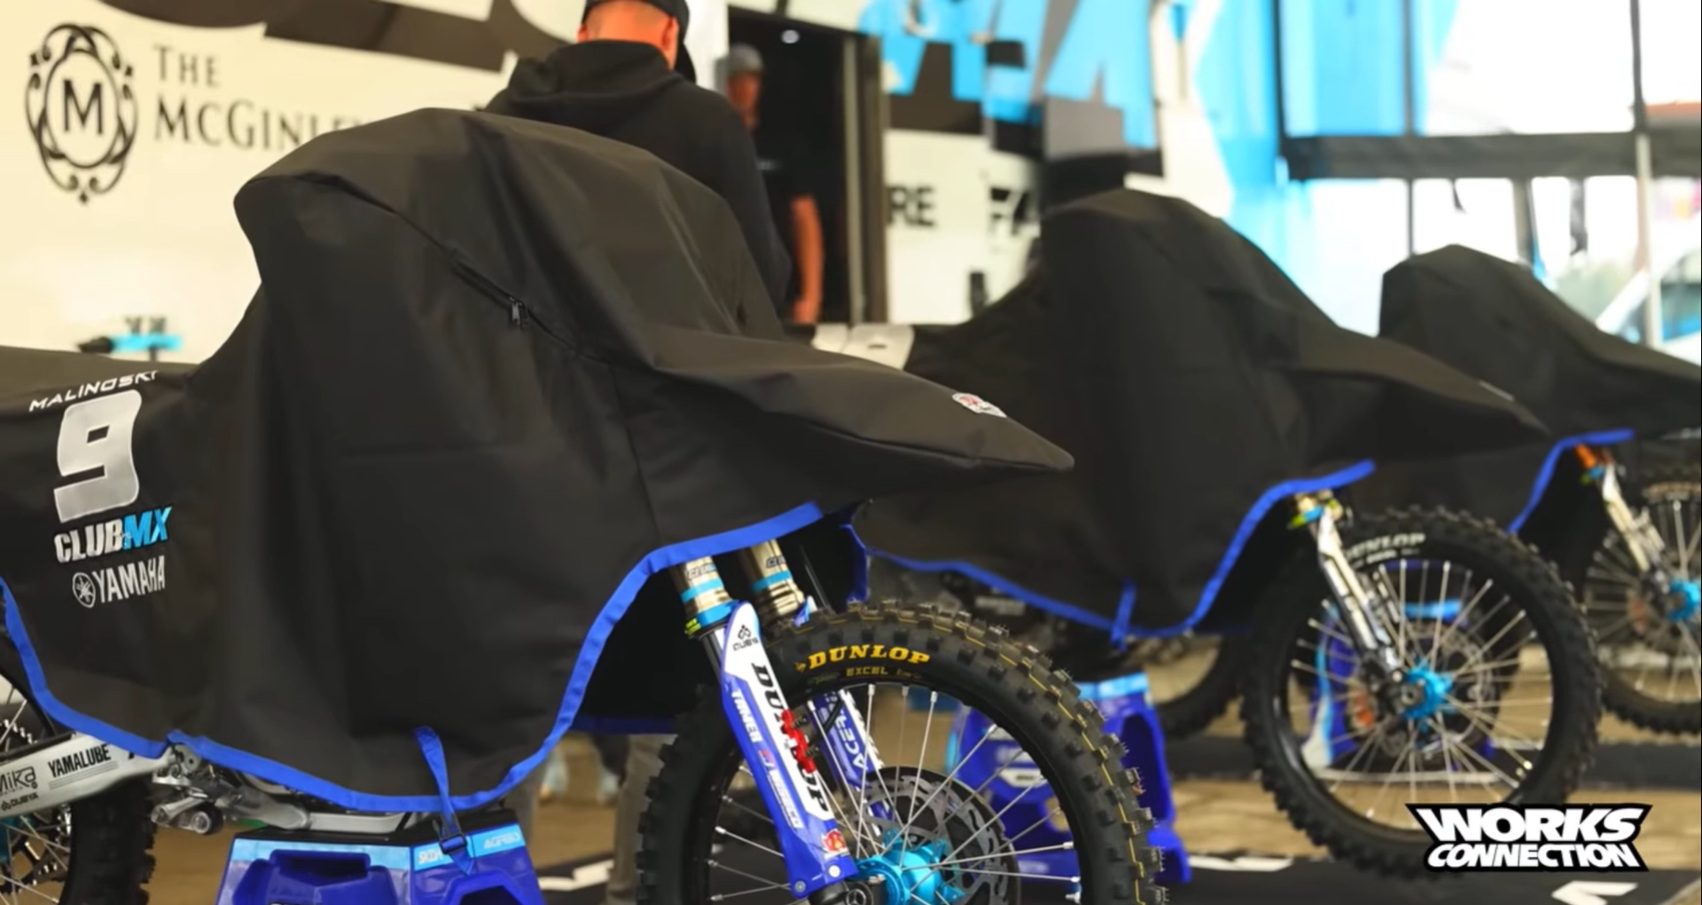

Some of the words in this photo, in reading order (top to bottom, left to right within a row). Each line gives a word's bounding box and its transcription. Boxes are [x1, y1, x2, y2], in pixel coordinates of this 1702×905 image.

[53, 389, 142, 523] 9
[93, 555, 165, 603] YAMAHA
[808, 644, 930, 669] DUNLOP
[48, 744, 111, 778] YAMALUBE
[752, 662, 828, 812] DUOP
